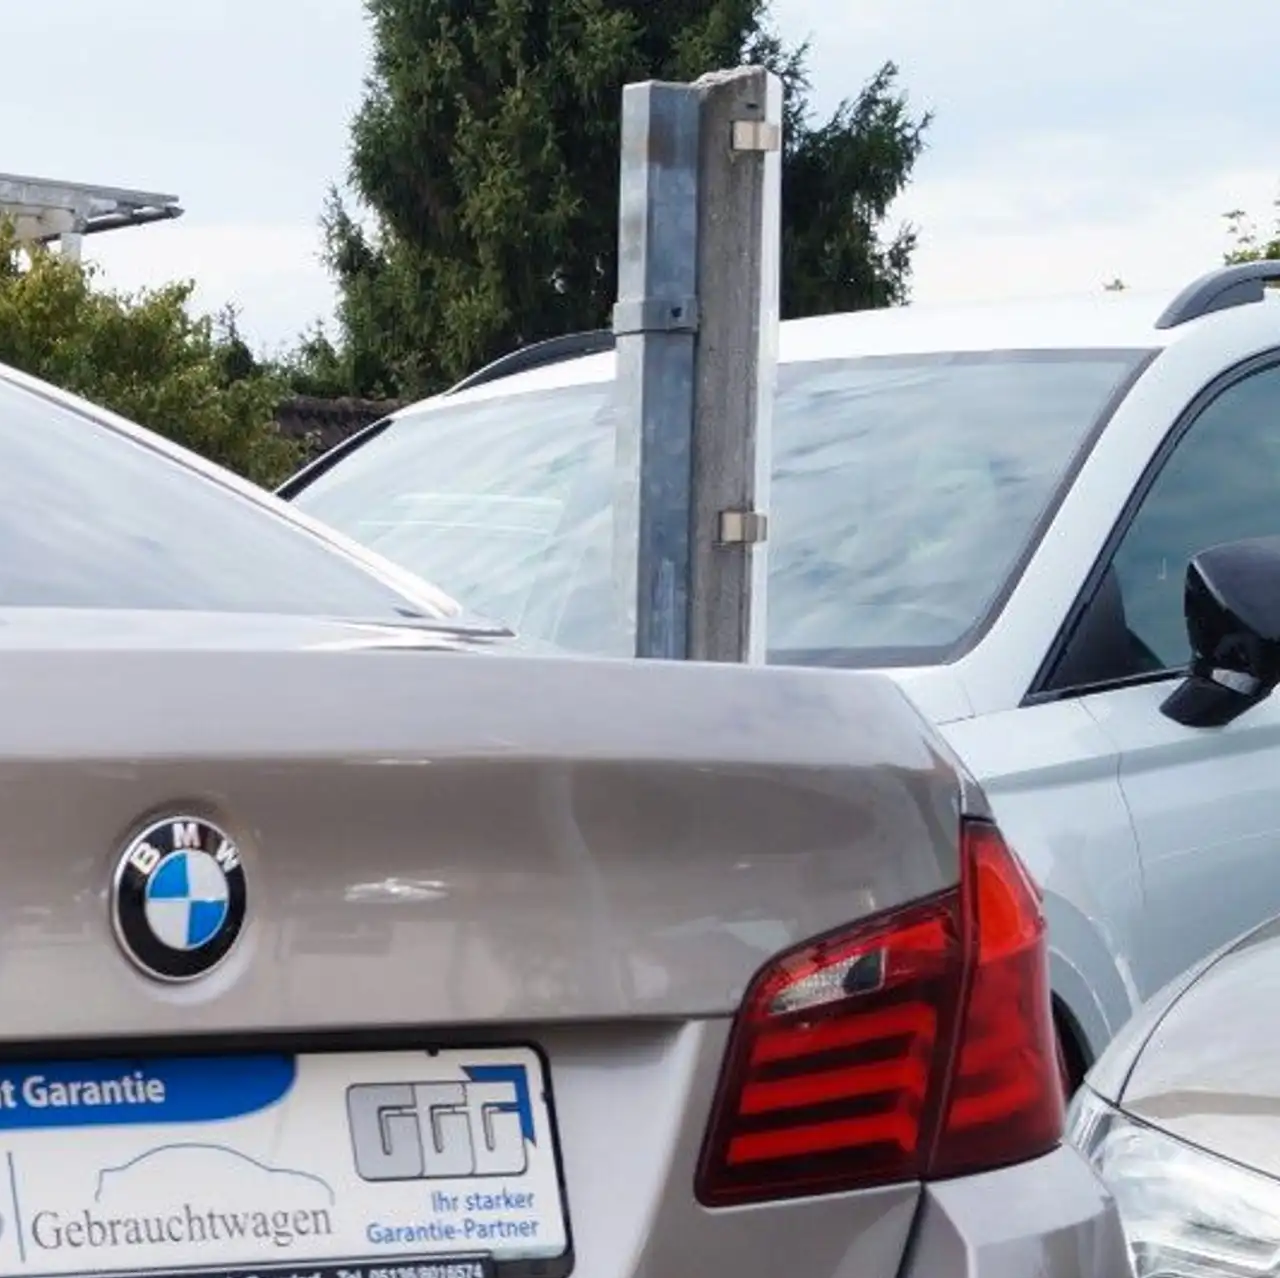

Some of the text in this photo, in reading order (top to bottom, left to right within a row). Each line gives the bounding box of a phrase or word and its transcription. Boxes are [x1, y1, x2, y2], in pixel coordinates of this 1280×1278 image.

[130, 822, 242, 875] BMW
[22, 1072, 167, 1108] Garantie
[431, 1188, 535, 1212] Ihr starker
[31, 1204, 333, 1250] Gebrauchtwagen
[366, 1218, 539, 1244] Garantie-Partner
